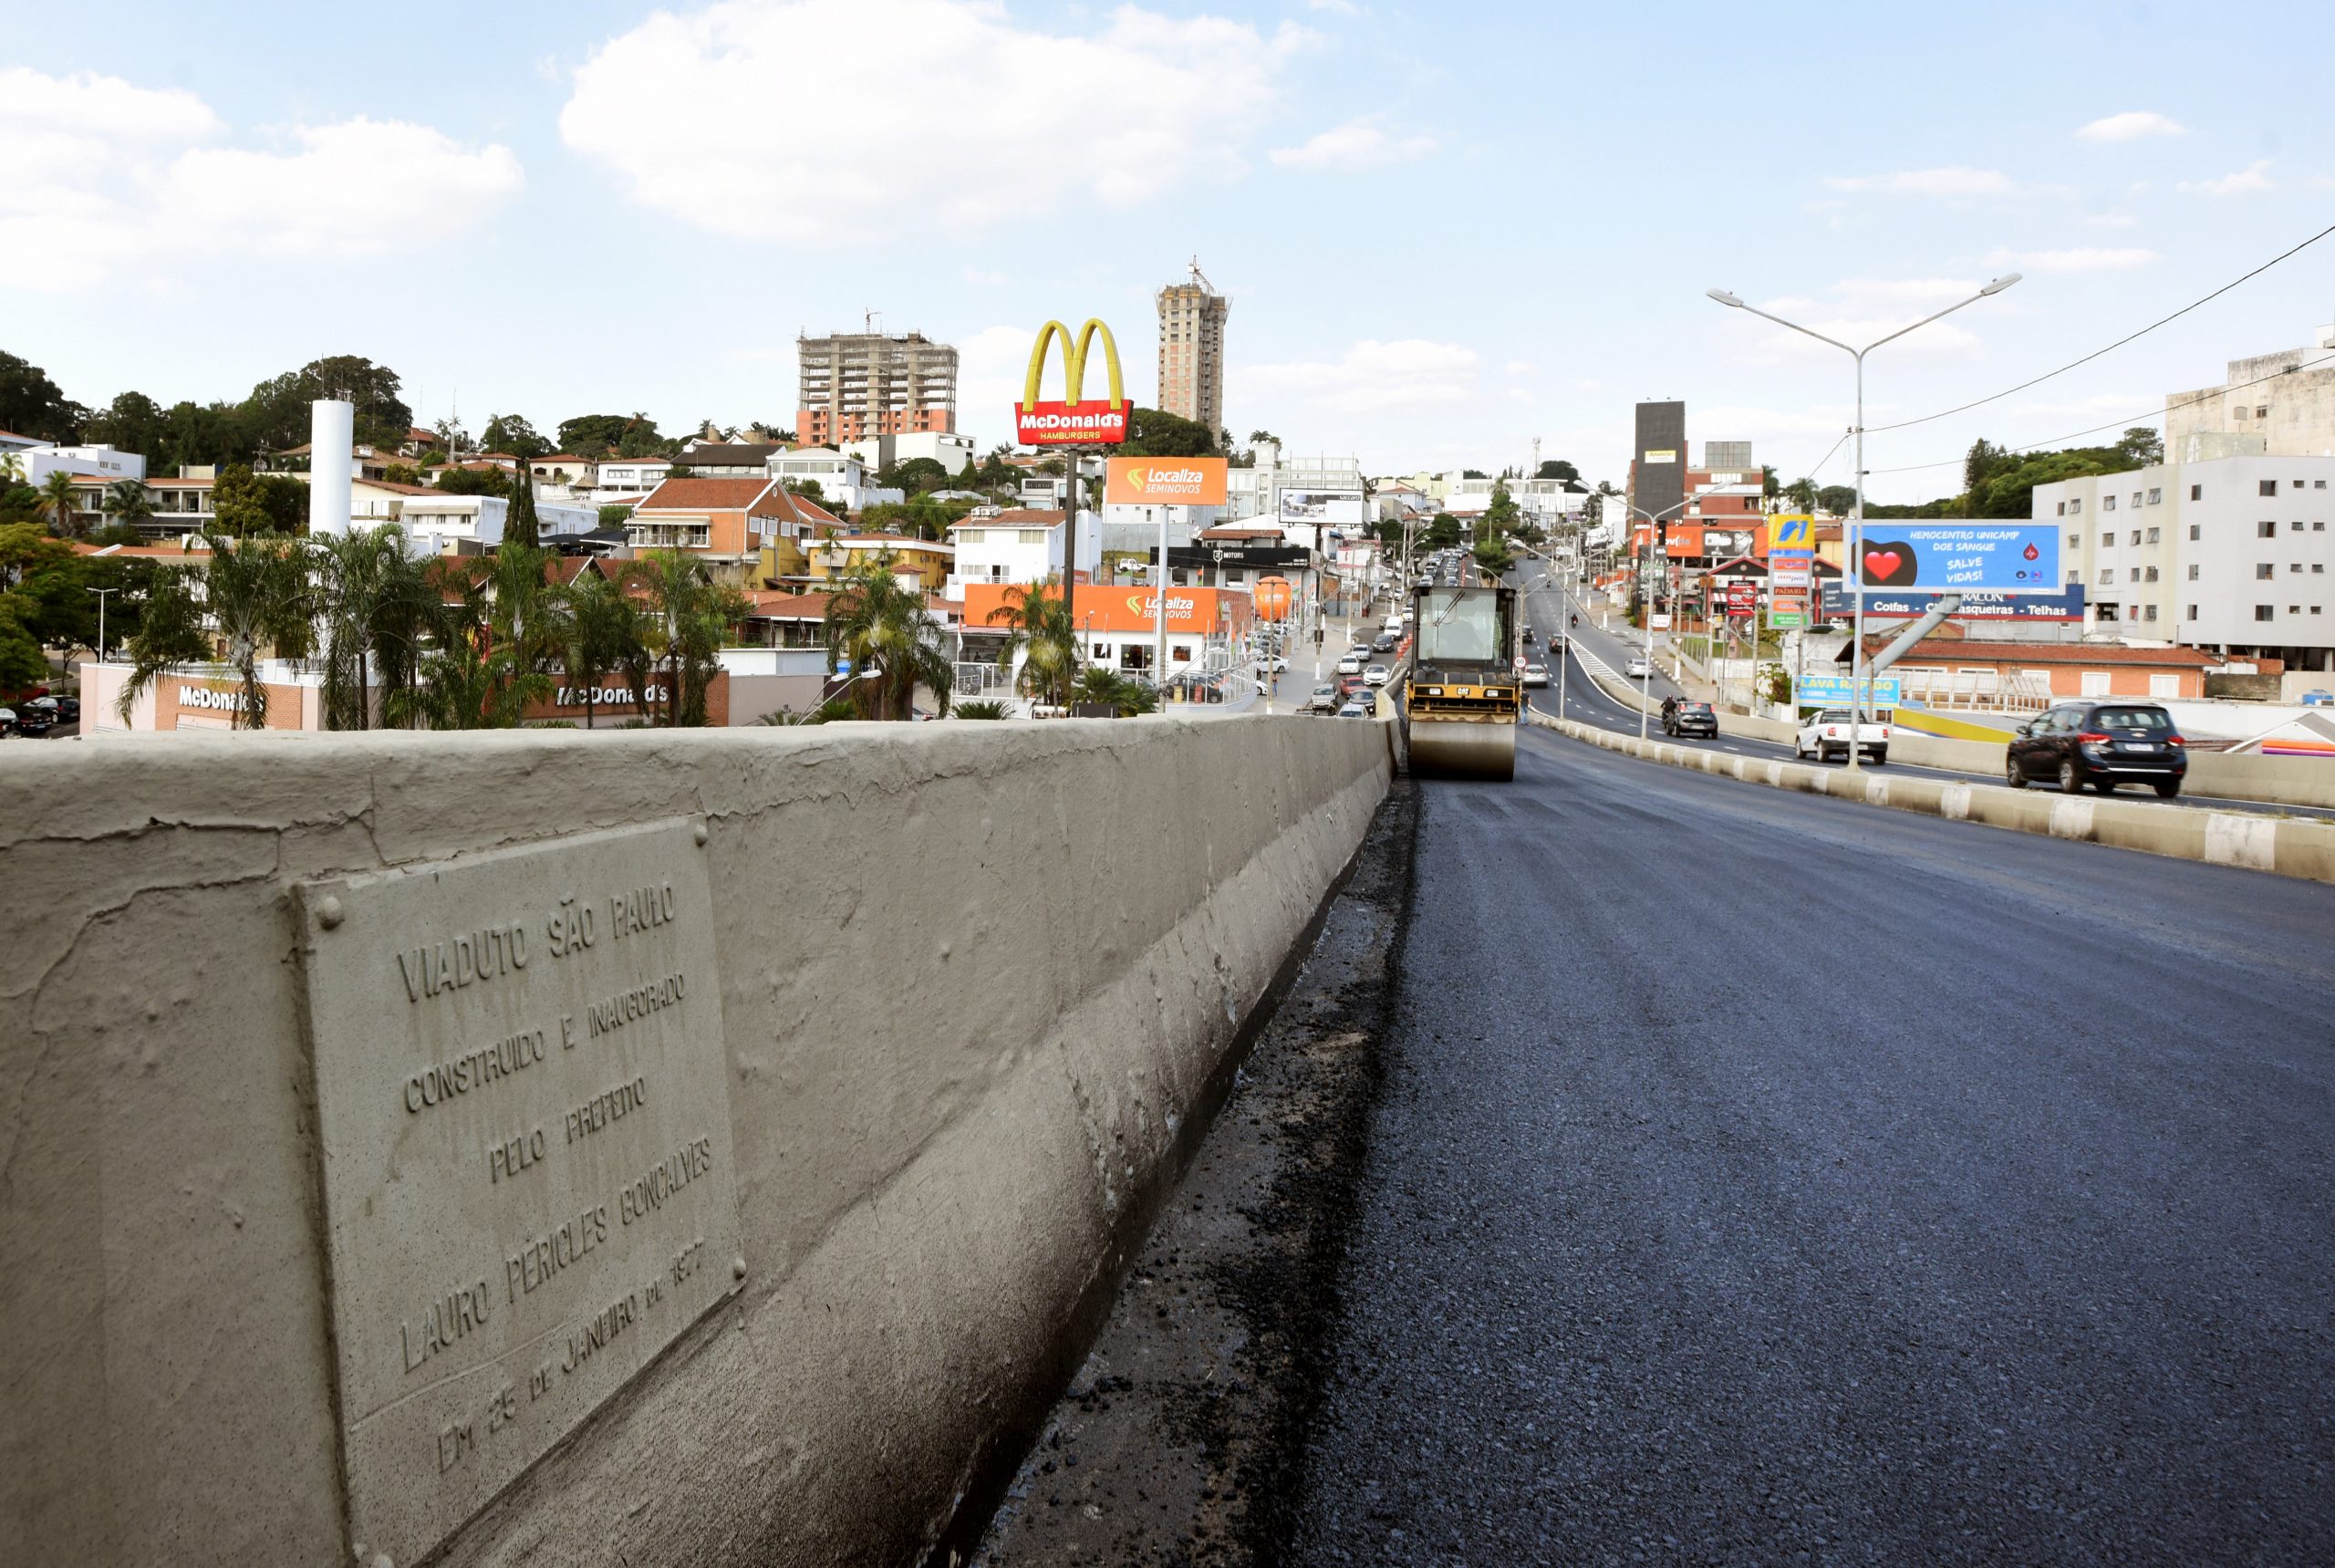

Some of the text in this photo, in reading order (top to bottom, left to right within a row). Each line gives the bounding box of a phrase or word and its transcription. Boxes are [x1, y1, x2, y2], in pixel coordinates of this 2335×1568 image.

[1020, 413, 1123, 429] McDonald's
[1040, 431, 1101, 441] HAMBURGERS
[1147, 468, 1204, 483] Localiza
[1145, 484, 1201, 494] SEMINOVOS
[1910, 531, 2021, 541] HEMOCENTRO UNICAMP
[1933, 543, 1996, 552] DOE SANGUE
[1946, 556, 1983, 570] SALVE
[1946, 569, 1983, 584] VIDAS!
[1774, 587, 1807, 595] PADARIA
[1145, 597, 1194, 609] Loaliza
[1873, 601, 1909, 612] Coifas
[1925, 602, 2014, 616] Casqueiras
[2027, 605, 2068, 616] Telhas
[1801, 678, 1835, 689] LAVA
[396, 881, 676, 1003] VIADUTO SÃO PAULO
[403, 1028, 546, 1114] CONSTRUIDO
[559, 1014, 576, 1050] E
[489, 1075, 647, 1184] PELO PREFEITO
[400, 1280, 489, 1376] LAURO
[617, 1133, 713, 1226] GONÇALVES
[437, 1418, 474, 1475] EM
[528, 1362, 553, 1403] DE
[561, 1293, 637, 1375] JANEIRO
[669, 1235, 705, 1288] 1977
